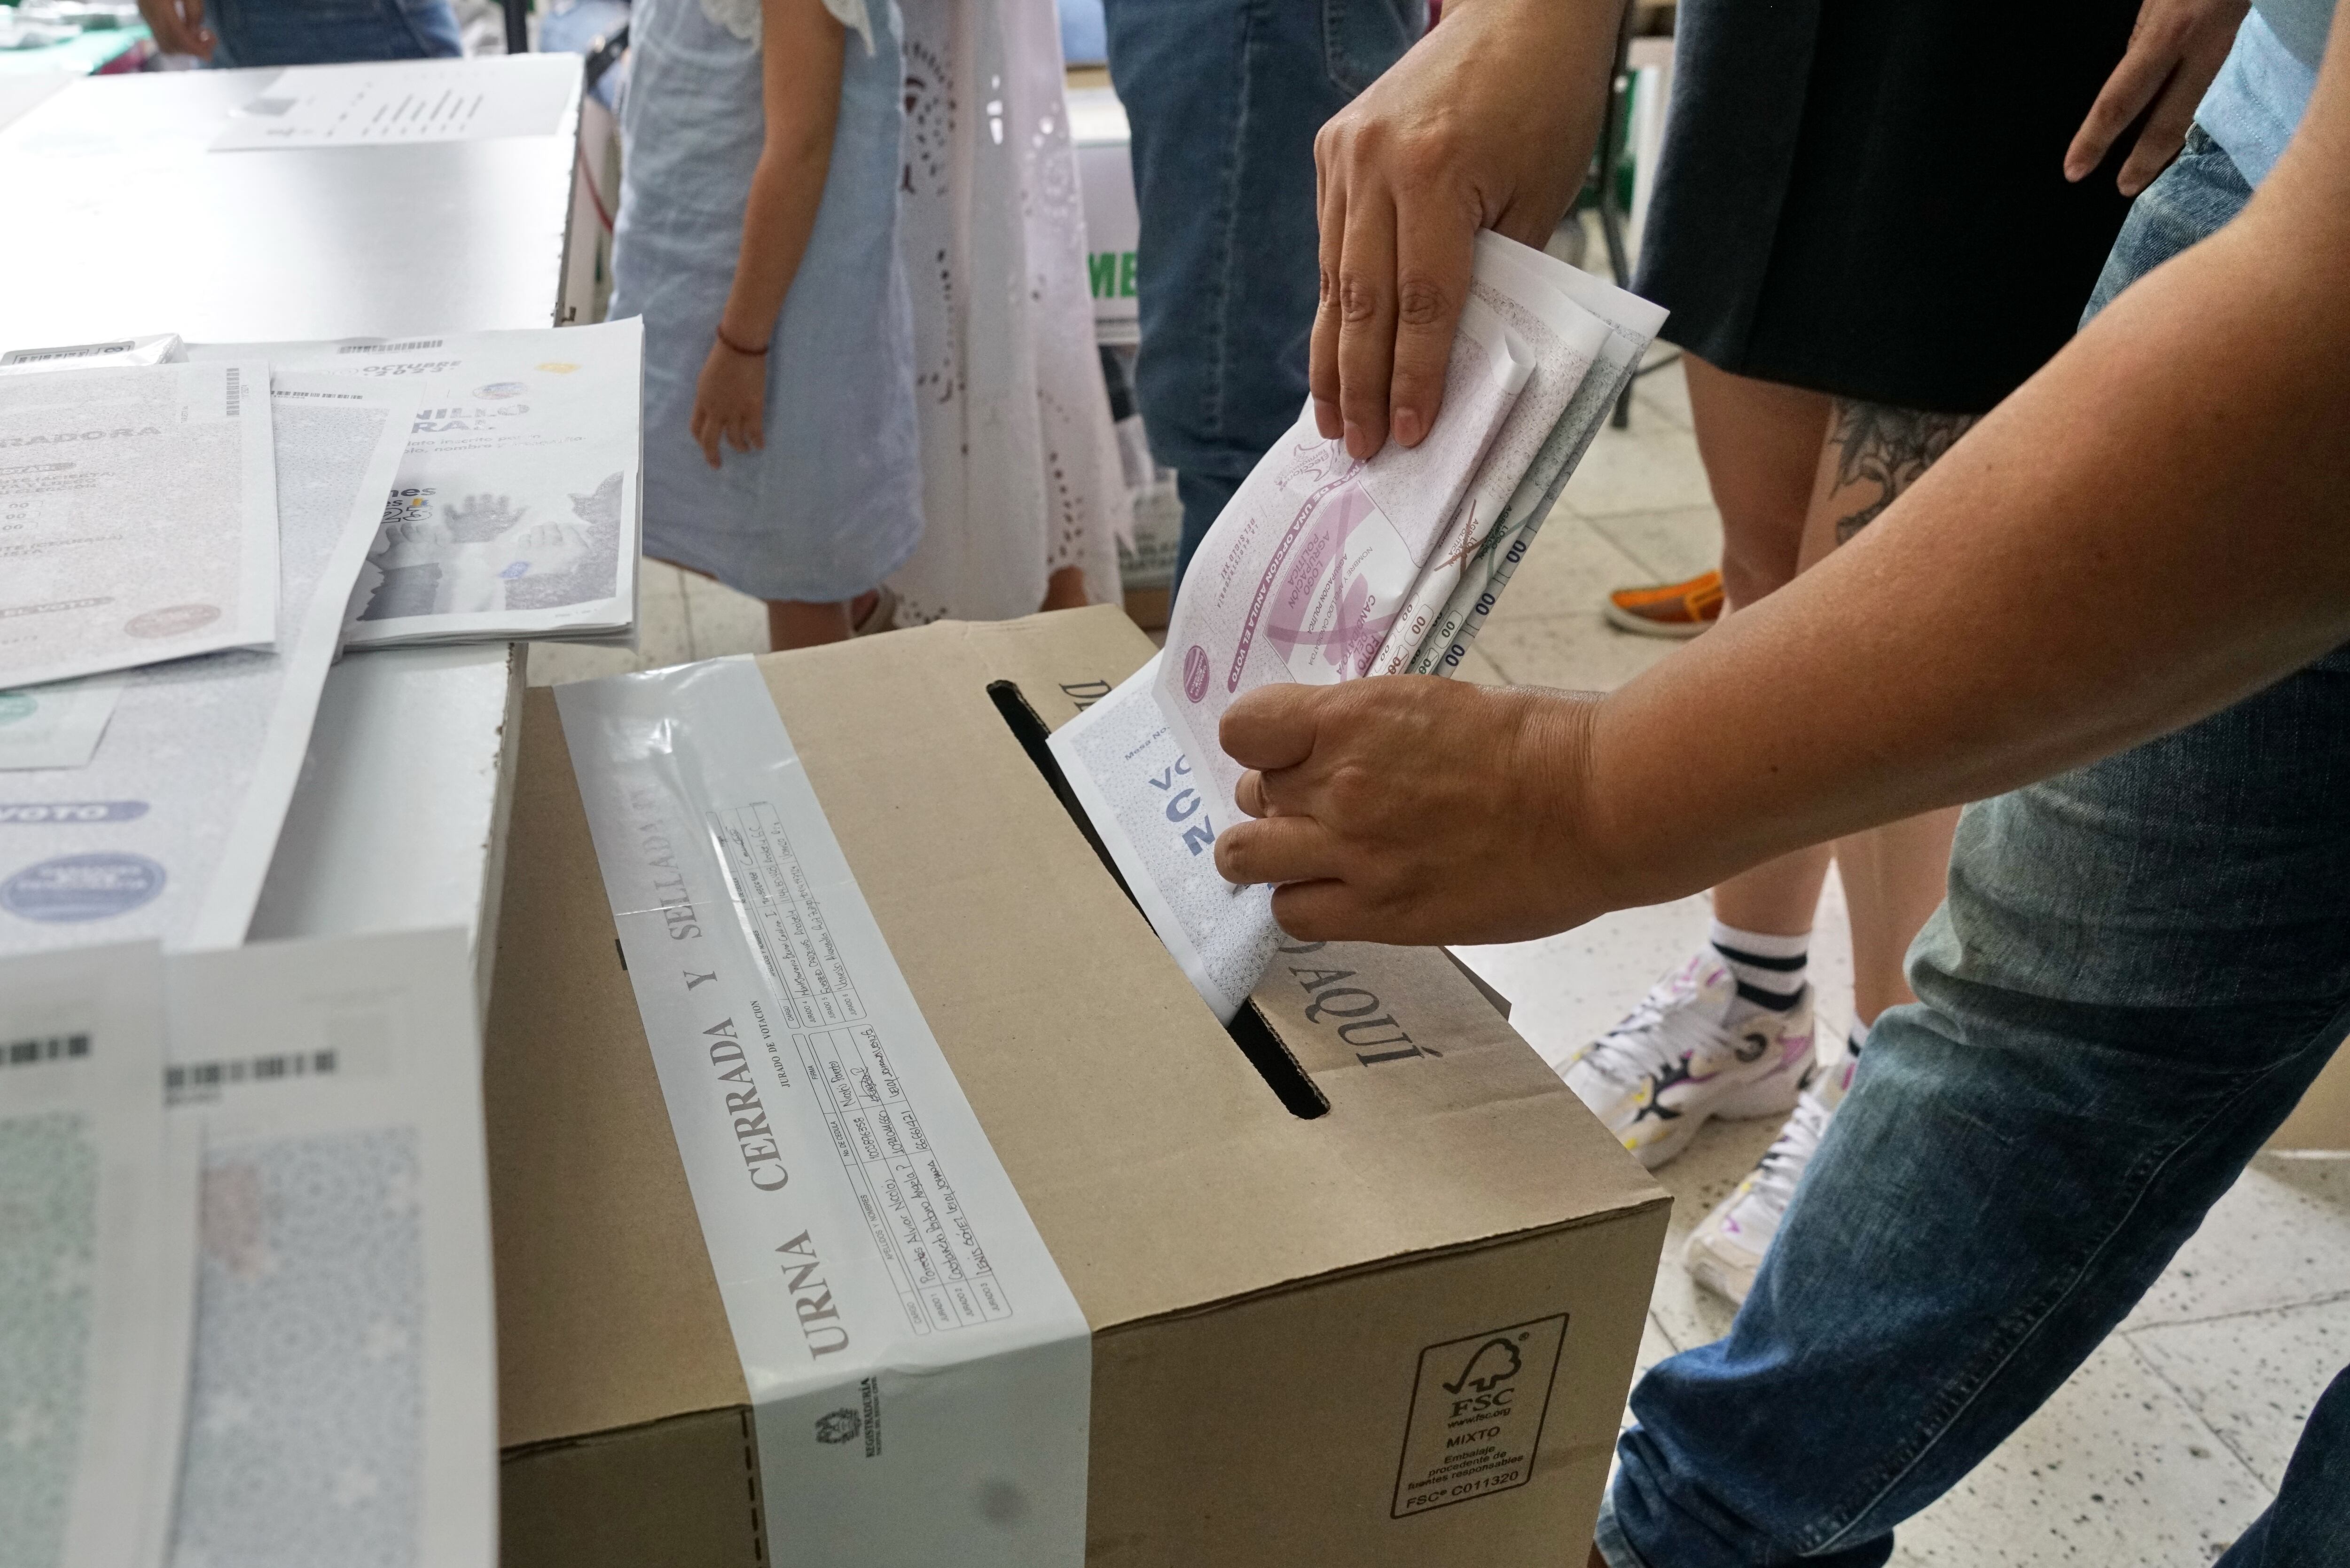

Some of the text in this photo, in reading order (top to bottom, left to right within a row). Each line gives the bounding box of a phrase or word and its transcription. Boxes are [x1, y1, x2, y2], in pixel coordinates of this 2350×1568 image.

[363, 360, 462, 372] OCTUBRE
[434, 443, 492, 452] nombre
[1313, 487, 1330, 502] DE
[1293, 503, 1313, 531] UNA
[1221, 517, 1255, 580] DEL SIGLO XXI
[1266, 534, 1293, 582] OPCIÓN
[1287, 533, 1318, 586] POLÍTICA
[1506, 540, 1527, 564] 00
[1288, 530, 1330, 609] AGRUPACIÓN
[1346, 546, 1373, 577] NOMBRE
[1303, 560, 1324, 595] LOGO
[1307, 553, 1347, 635] AGRUPACIÓN POLÍTICA
[1325, 583, 1344, 619] APELLIDO
[1475, 593, 1496, 616] 00
[1248, 587, 1267, 628] ANULA
[1402, 604, 1413, 621] 00
[1336, 595, 1376, 675] CANDIDATO/A
[1411, 616, 1426, 635] 00
[1441, 621, 1456, 638] 00
[1241, 631, 1252, 647] EL
[1354, 635, 1368, 654] DEL
[1358, 635, 1380, 671] FOTO
[1380, 644, 1390, 662] 00
[1445, 644, 1465, 667] 00
[1232, 649, 1246, 683] VOTO
[1388, 656, 1402, 674] 00
[1418, 658, 1432, 674] 00
[1124, 726, 1170, 761] Mesa No.
[752, 930, 764, 949] NOMBRES
[763, 955, 776, 977] APELLIDOS
[682, 970, 718, 991] Y
[783, 1006, 794, 1021] CARGO
[804, 1005, 816, 1022] JURADO
[823, 1002, 836, 1018] JURADO
[844, 998, 857, 1015] JURADO
[1287, 965, 1445, 1067] AQUÍ
[750, 1000, 791, 1088] JURADO DE VOTACION
[808, 1065, 818, 1079] FIRMA
[702, 1017, 789, 1192] CERRADA
[830, 1121, 843, 1140] CEDULA
[860, 1194, 876, 1221] NOMBRES
[876, 1230, 893, 1259] APELLIDOS
[776, 1228, 850, 1361] URNA
[957, 1293, 974, 1316] JURADO
[983, 1287, 1000, 1310] JURADO
[932, 1298, 949, 1321] JURADO
[1449, 1387, 1515, 1419] FSC
[1447, 1407, 1512, 1429] www.fsc.org
[1446, 1426, 1501, 1449] MIXTO
[1429, 1450, 1507, 1478] procedente de
[1444, 1445, 1496, 1464] Embalaje
[1408, 1454, 1524, 1491] fuentes responsables
[1451, 1470, 1519, 1497] C011320
